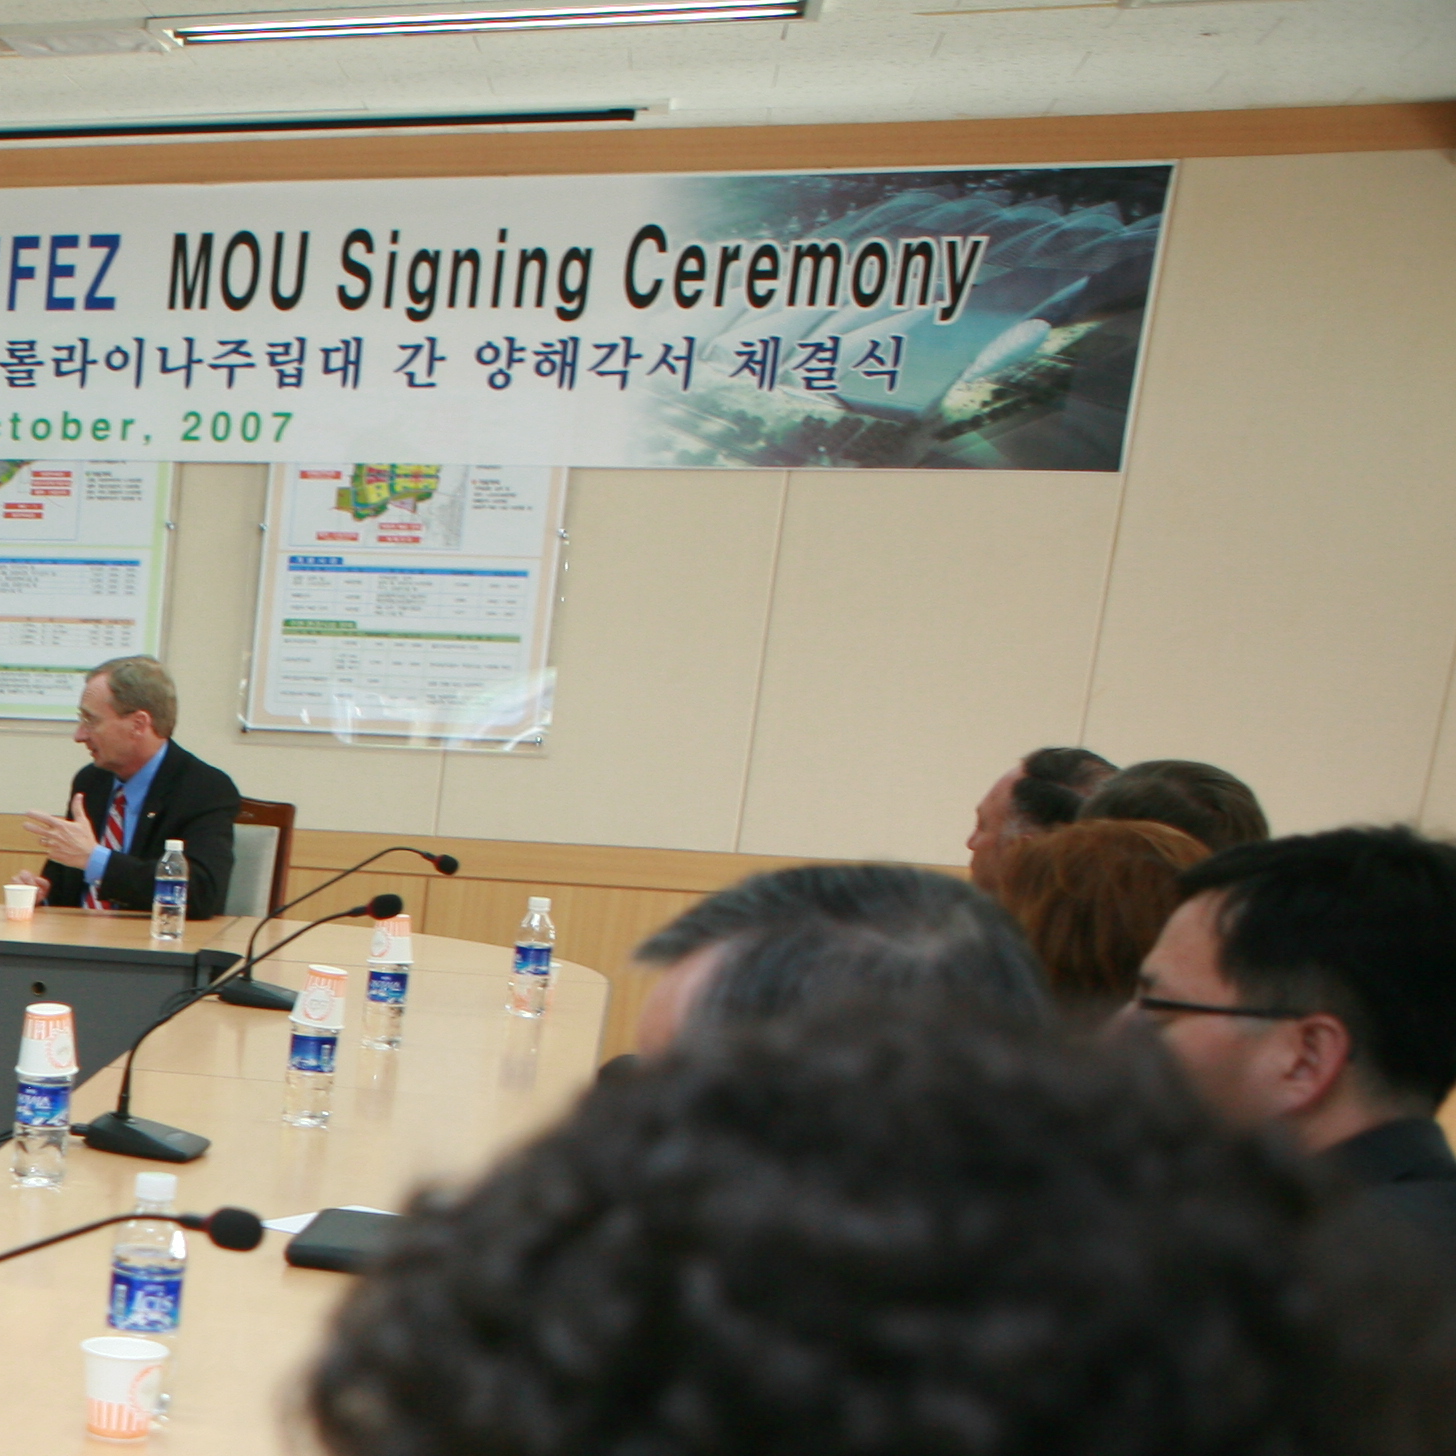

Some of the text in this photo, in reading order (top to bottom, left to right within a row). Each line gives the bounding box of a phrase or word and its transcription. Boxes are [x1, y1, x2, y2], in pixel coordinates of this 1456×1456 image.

[167, 229, 311, 311] MOU
[337, 228, 593, 322] Signing
[624, 223, 985, 323] Ceremony
[393, 336, 446, 388] 간
[474, 336, 696, 391] 양해각서
[729, 335, 906, 392] 체결식
[181, 410, 294, 442] 2007
